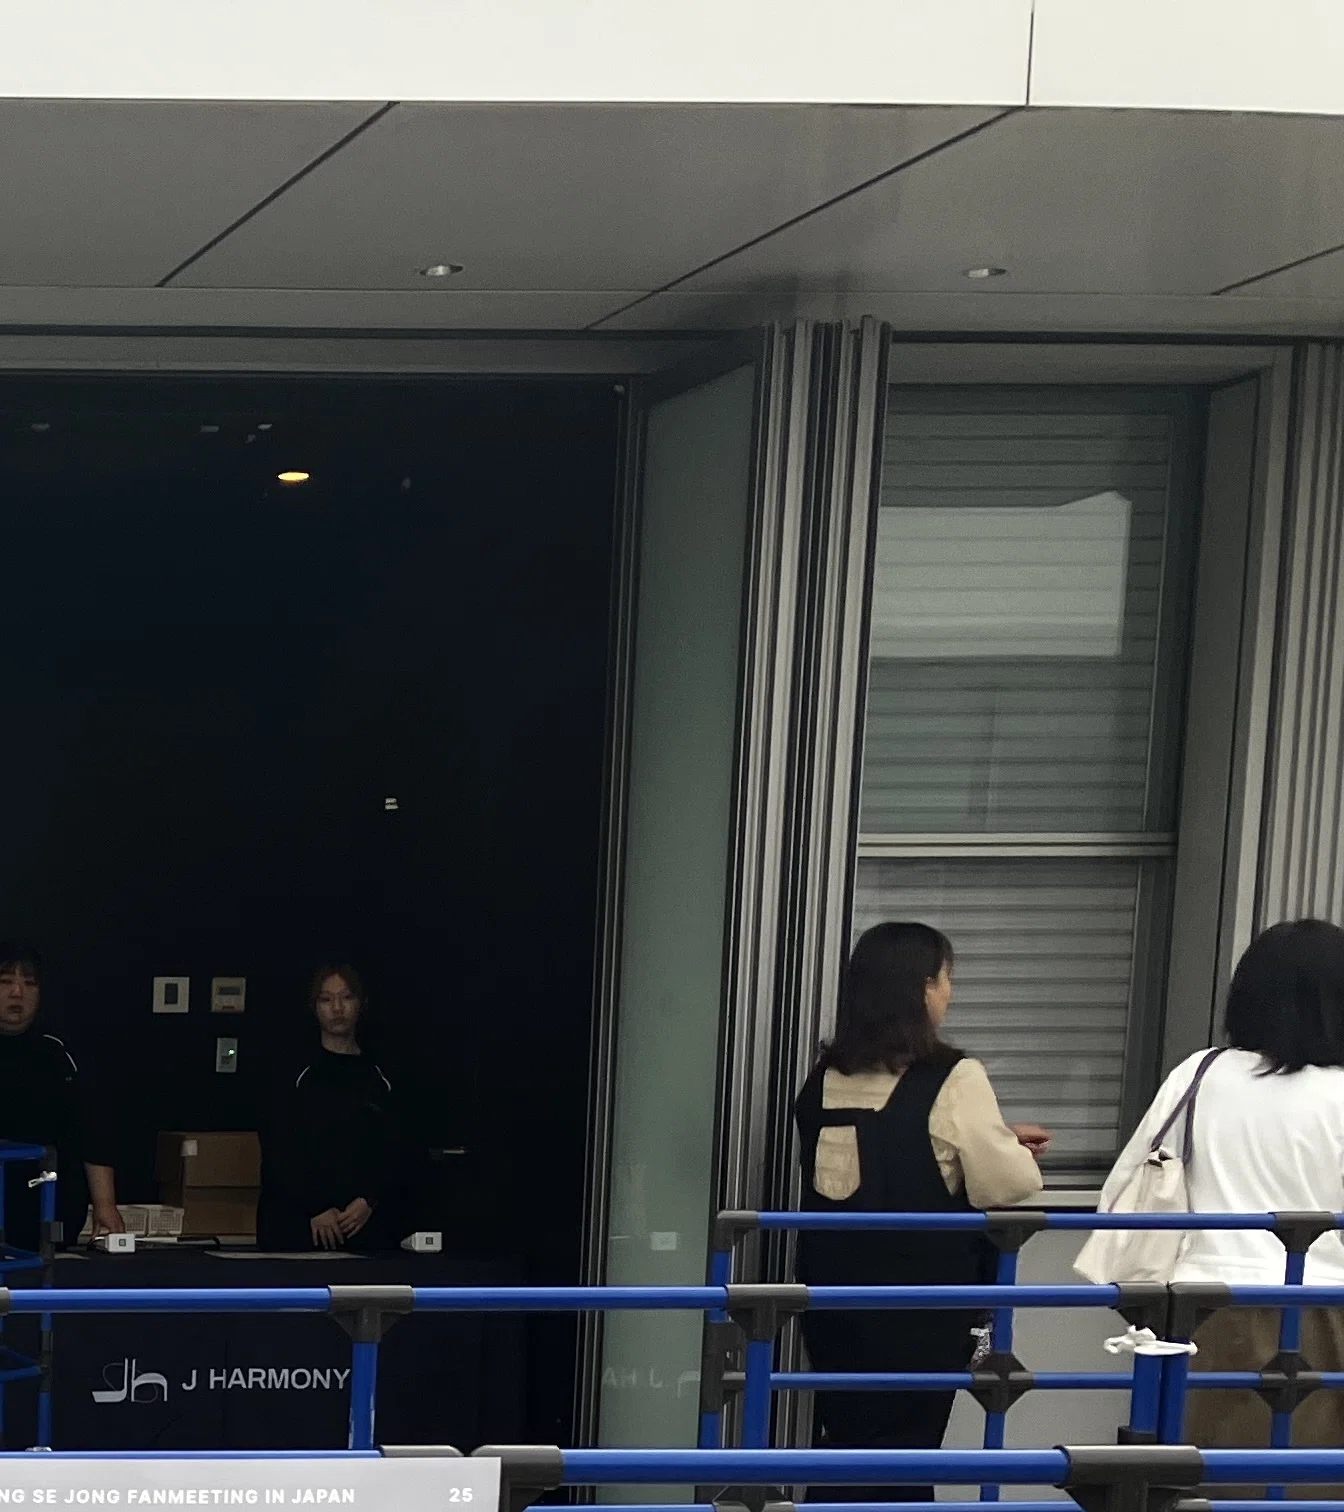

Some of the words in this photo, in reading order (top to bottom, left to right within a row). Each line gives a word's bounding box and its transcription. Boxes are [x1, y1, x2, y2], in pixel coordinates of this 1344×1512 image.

[181, 1369, 198, 1391] J
[209, 1367, 351, 1390] HARMONY
[33, 1489, 57, 1503] SE
[64, 1489, 120, 1504] JONG
[127, 1490, 258, 1504] FANMEETING
[265, 1489, 285, 1503] IN
[292, 1489, 355, 1503] JAPAN
[449, 1488, 473, 1502] 25
